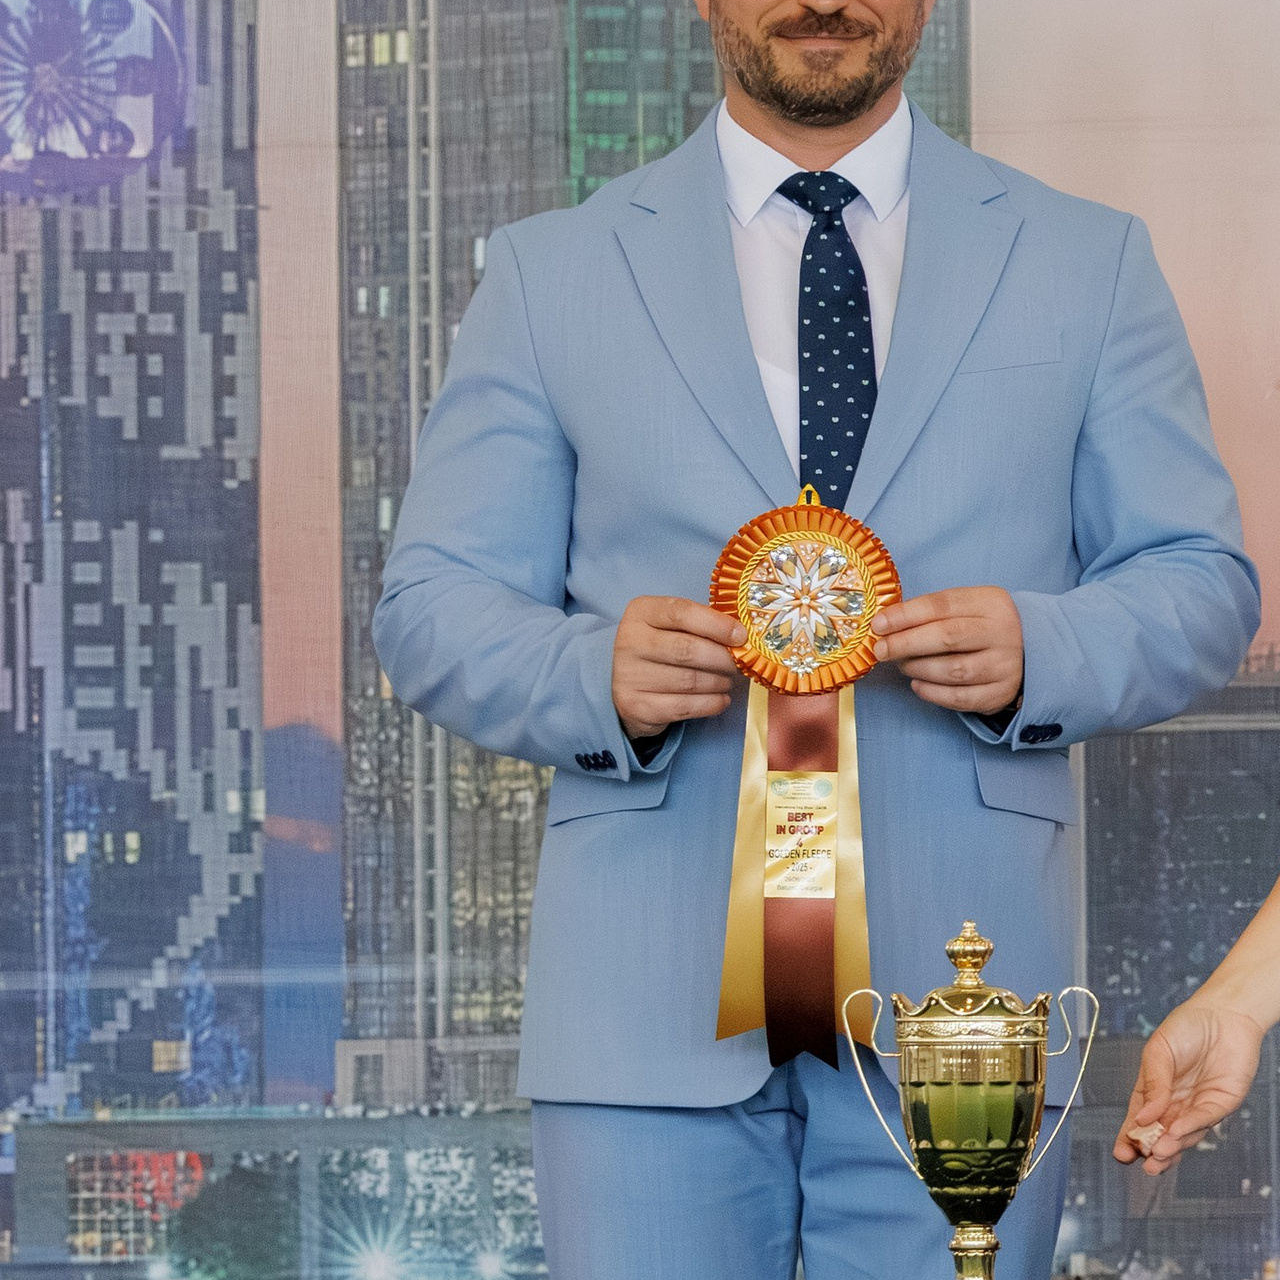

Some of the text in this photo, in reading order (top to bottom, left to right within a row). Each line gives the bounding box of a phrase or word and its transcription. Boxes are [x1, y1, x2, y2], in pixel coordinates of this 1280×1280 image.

[787, 812, 814, 822] BEST
[776, 824, 825, 836] IN GROUP
